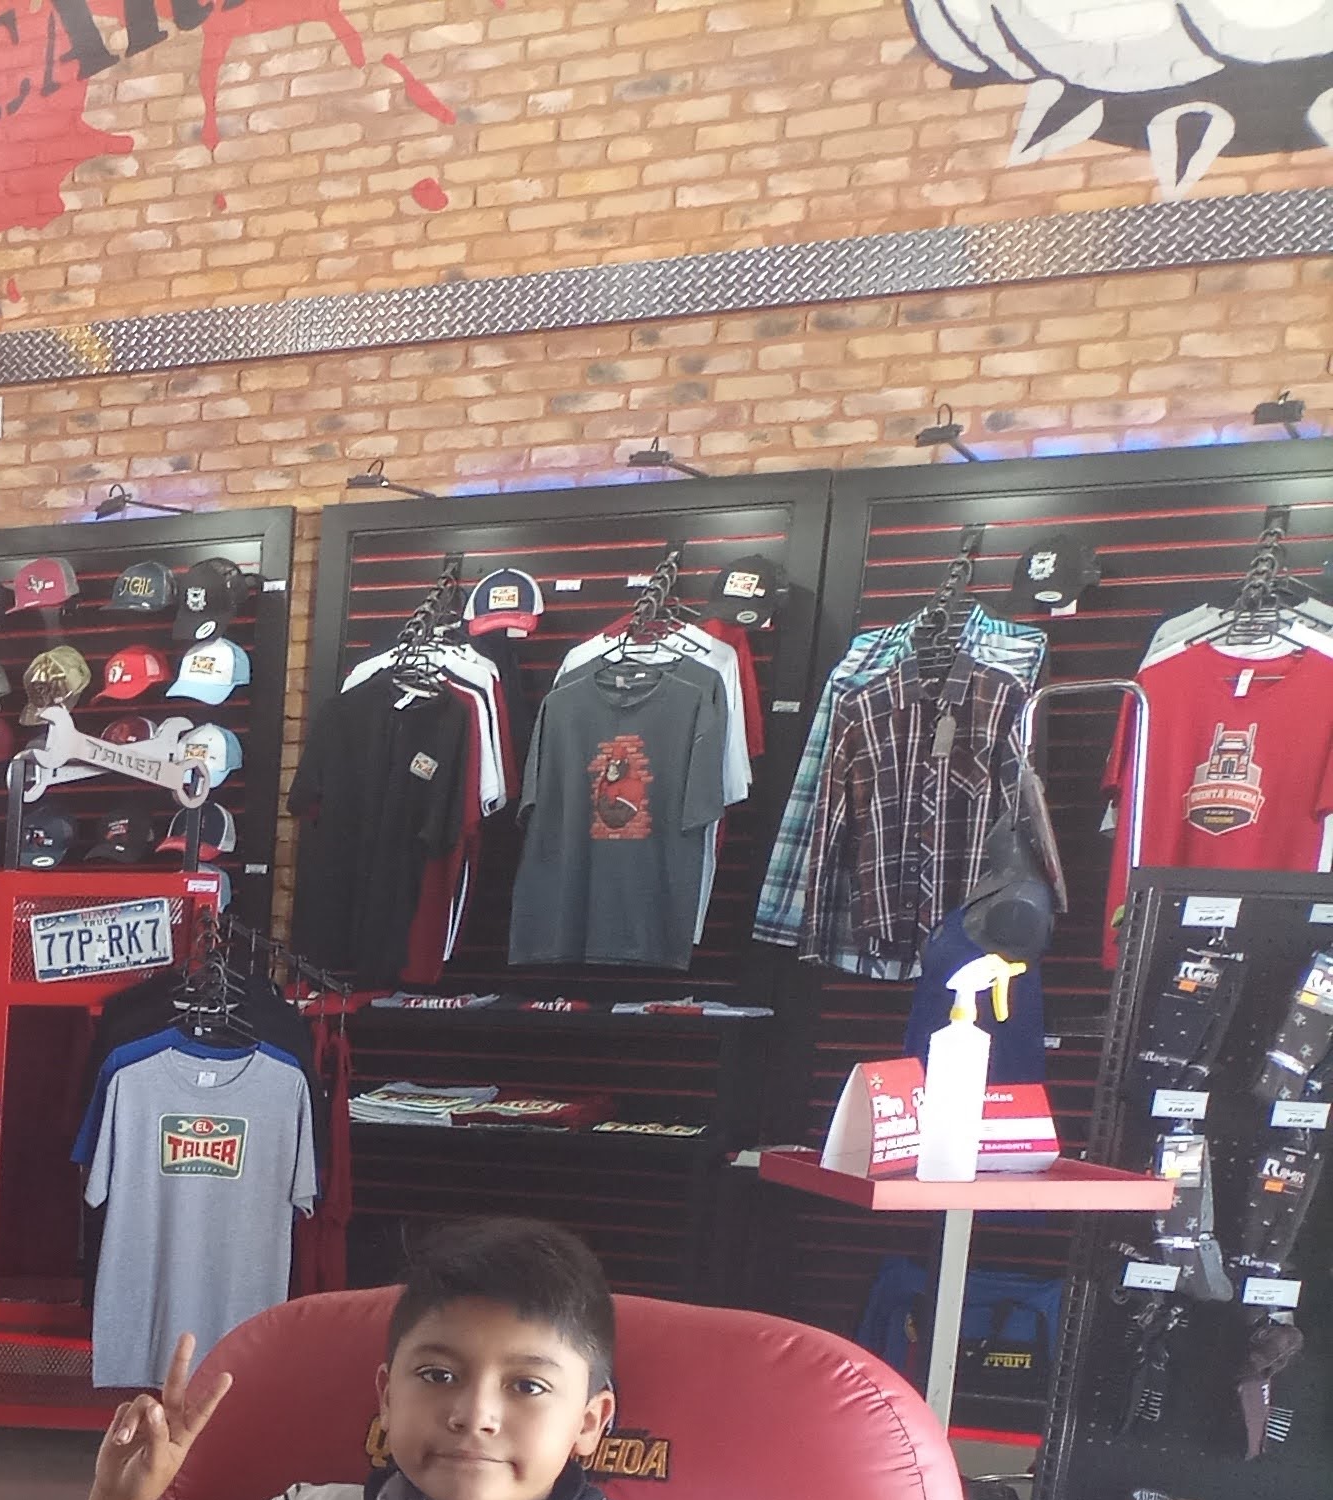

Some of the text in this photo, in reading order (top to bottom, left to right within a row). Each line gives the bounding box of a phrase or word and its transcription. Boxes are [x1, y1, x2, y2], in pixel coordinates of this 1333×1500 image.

[85, 738, 162, 781] TALLER
[83, 917, 116, 927] TRUCK
[39, 918, 161, 966] 77P RK7
[195, 1121, 210, 1132] EL
[167, 1135, 237, 1166] TALLER
[583, 1436, 668, 1479] EDA
